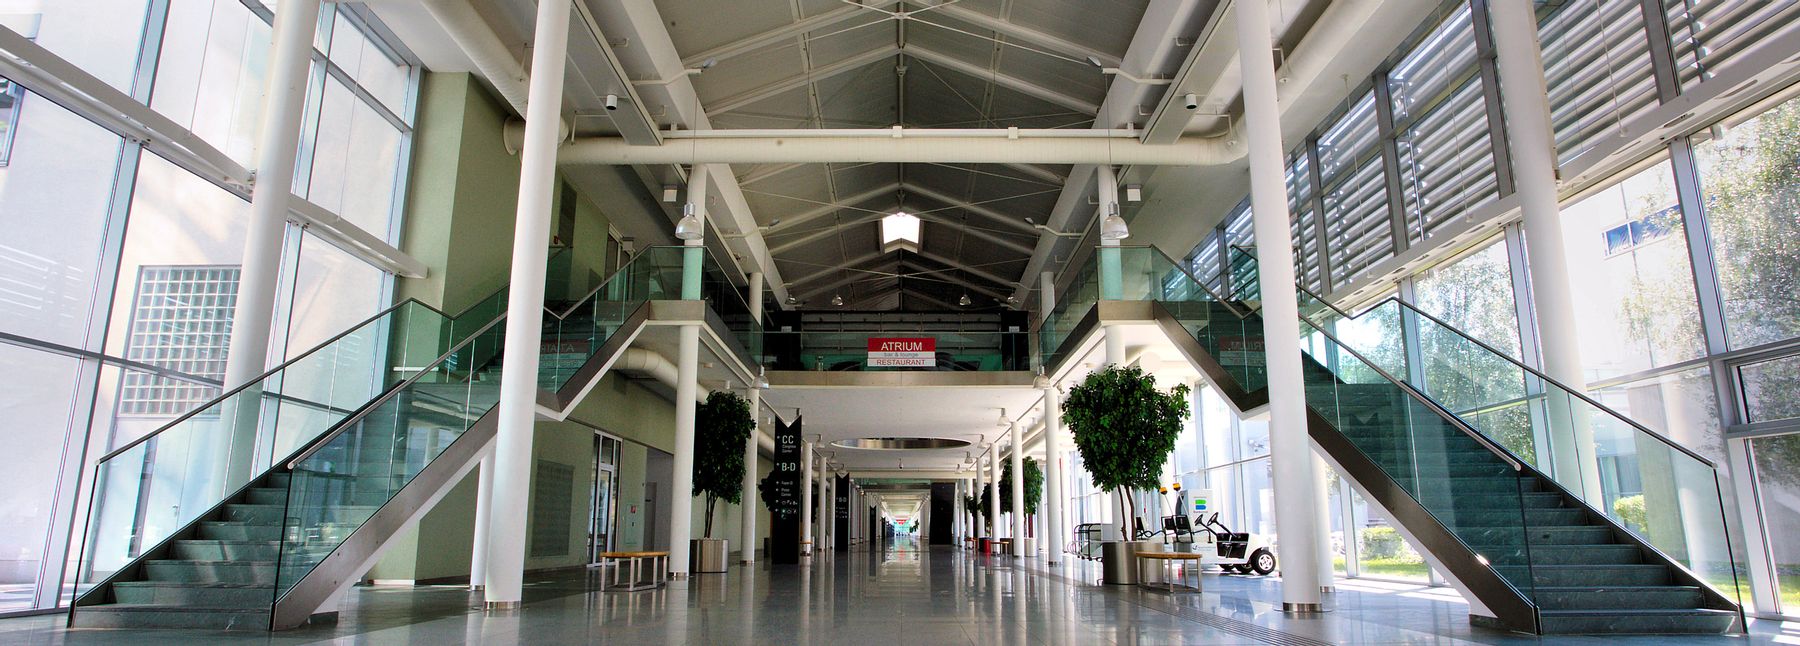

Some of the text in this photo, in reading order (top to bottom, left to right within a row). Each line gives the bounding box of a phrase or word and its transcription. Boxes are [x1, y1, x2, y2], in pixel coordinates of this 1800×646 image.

[881, 342, 922, 350] ATRIUM
[782, 435, 794, 444] CC
[782, 462, 796, 471] B-D
